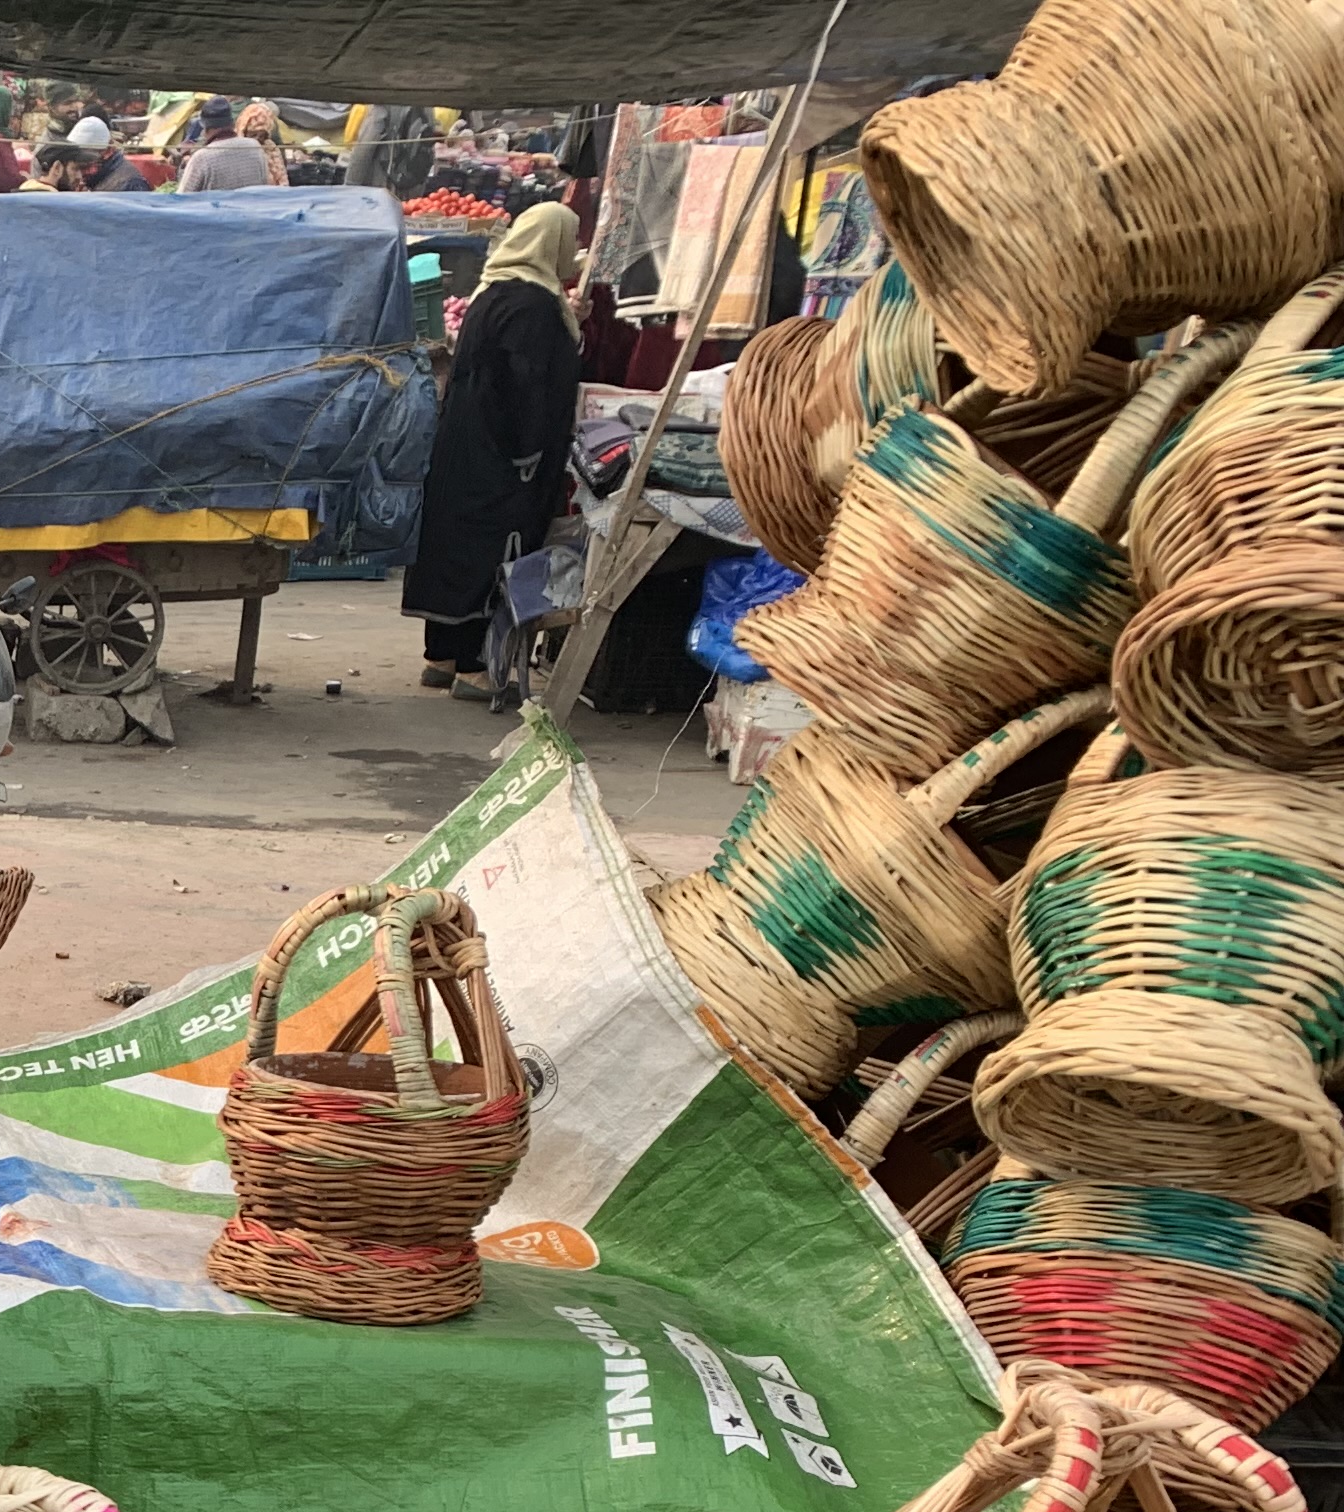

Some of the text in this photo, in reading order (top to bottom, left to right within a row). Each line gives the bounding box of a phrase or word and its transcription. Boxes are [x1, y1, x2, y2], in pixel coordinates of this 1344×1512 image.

[316, 915, 379, 968] ECH
[71, 1040, 142, 1072] HEN
[525, 1046, 556, 1086] COMPANY
[554, 1306, 656, 1459] FINISHER
